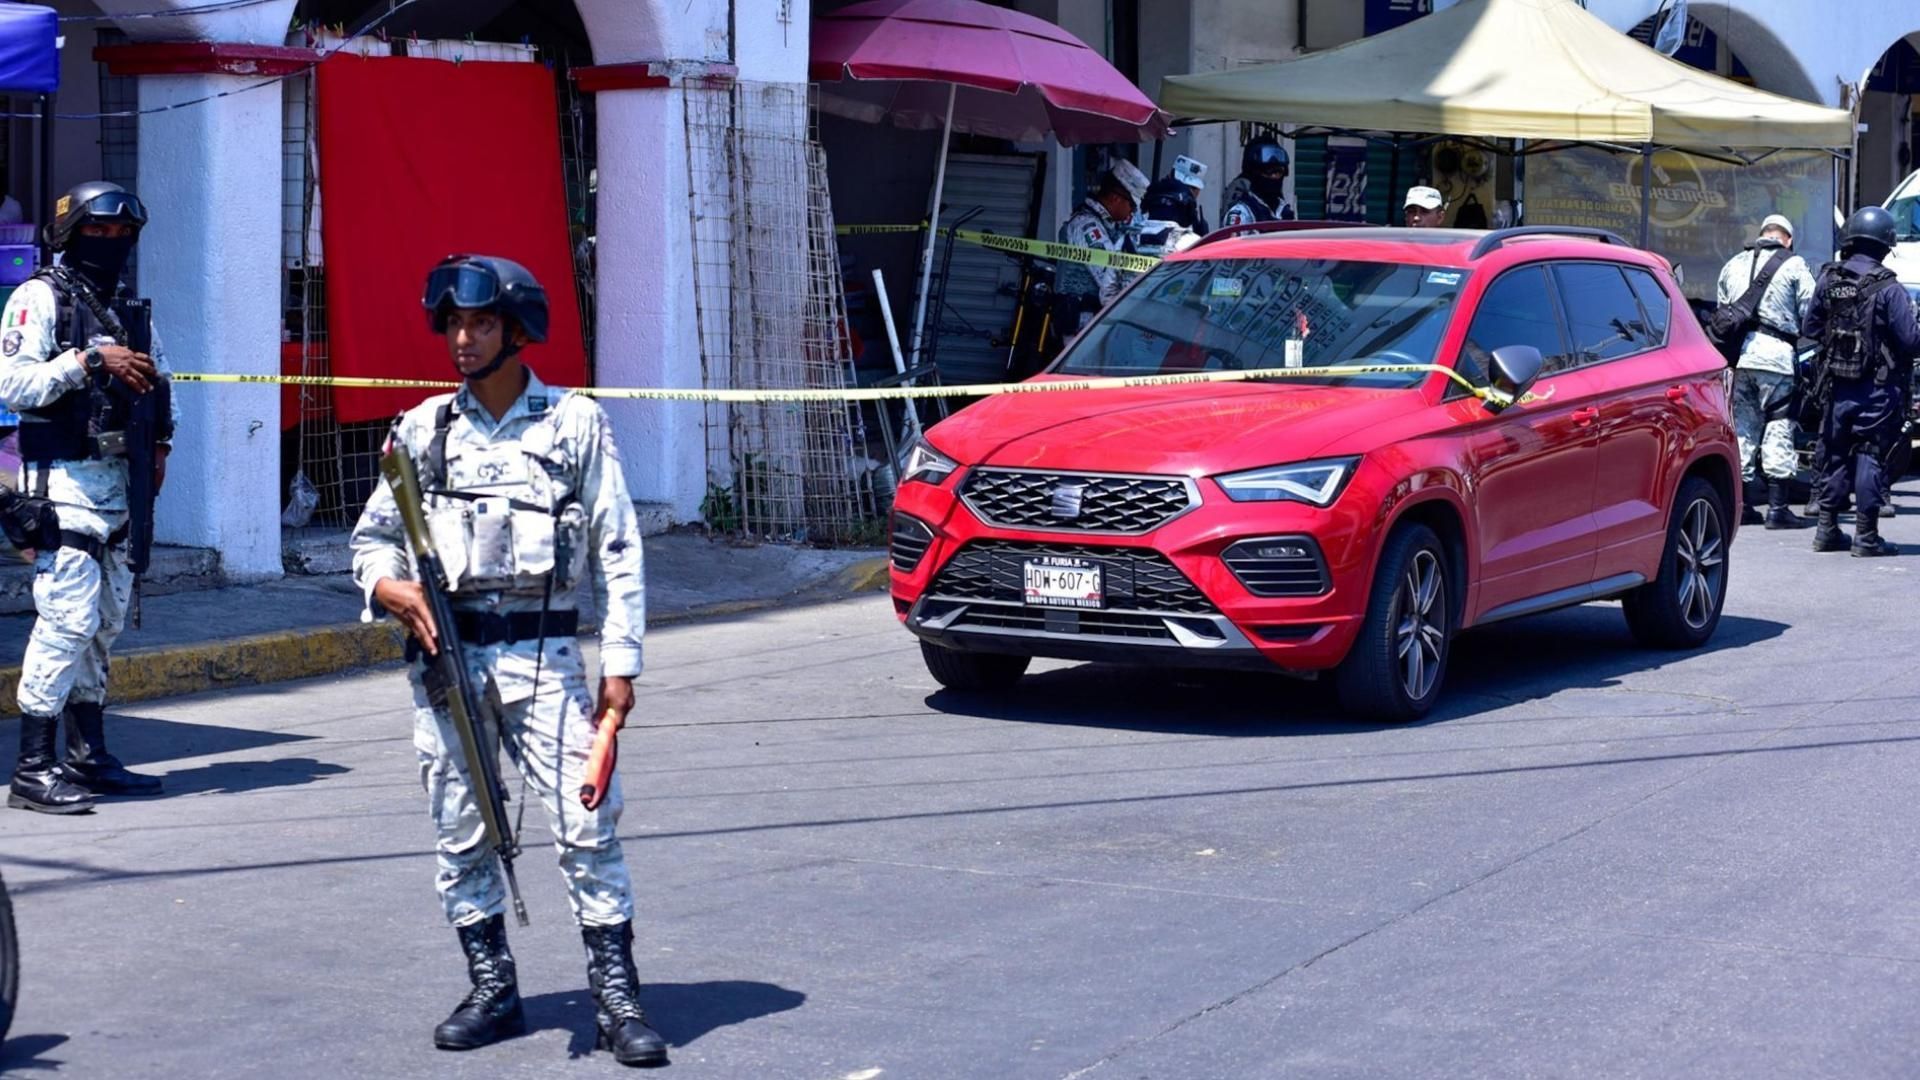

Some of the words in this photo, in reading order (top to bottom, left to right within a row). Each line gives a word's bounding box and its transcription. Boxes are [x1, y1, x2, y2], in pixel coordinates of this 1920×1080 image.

[1046, 243, 1091, 262] PRECAUCION
[1051, 557, 1073, 567] FURIA
[1026, 595, 1048, 604] GRUPO
